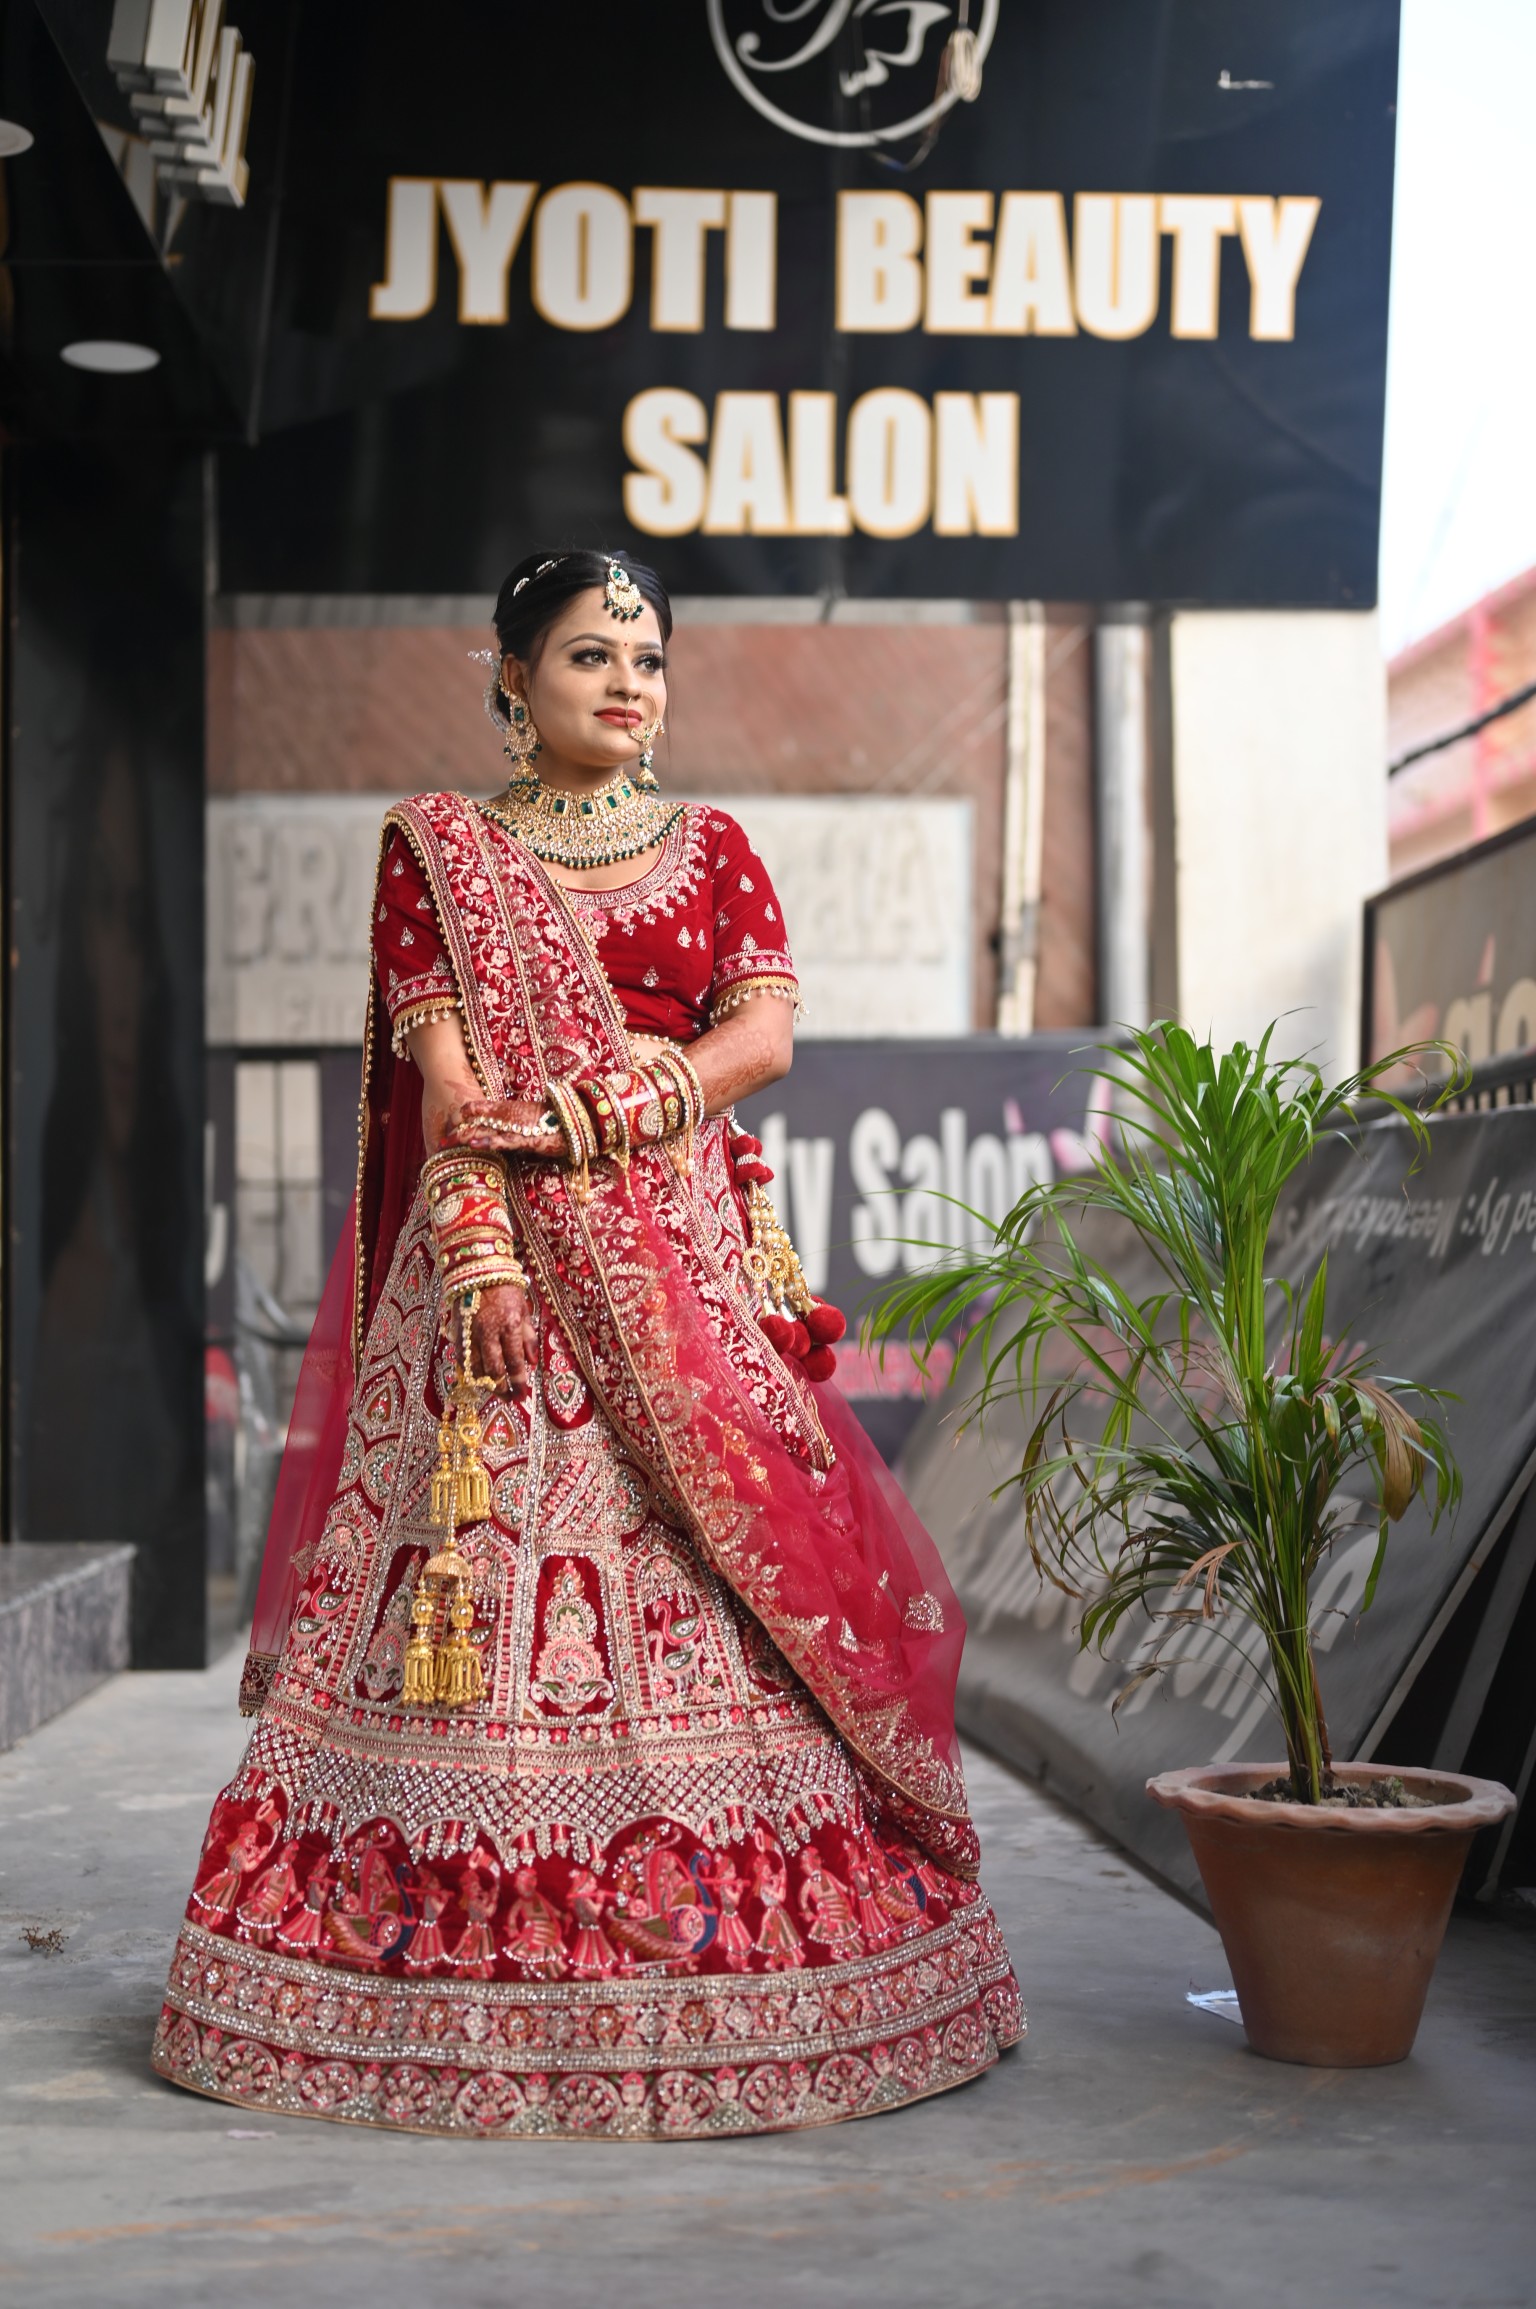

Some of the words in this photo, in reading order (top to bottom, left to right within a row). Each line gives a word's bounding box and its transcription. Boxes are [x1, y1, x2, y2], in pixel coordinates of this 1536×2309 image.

[369, 175, 777, 332] JYOTI
[834, 190, 1321, 341] BEAUTY
[622, 386, 1019, 538] SALON
[849, 1106, 1056, 1280] Salon
